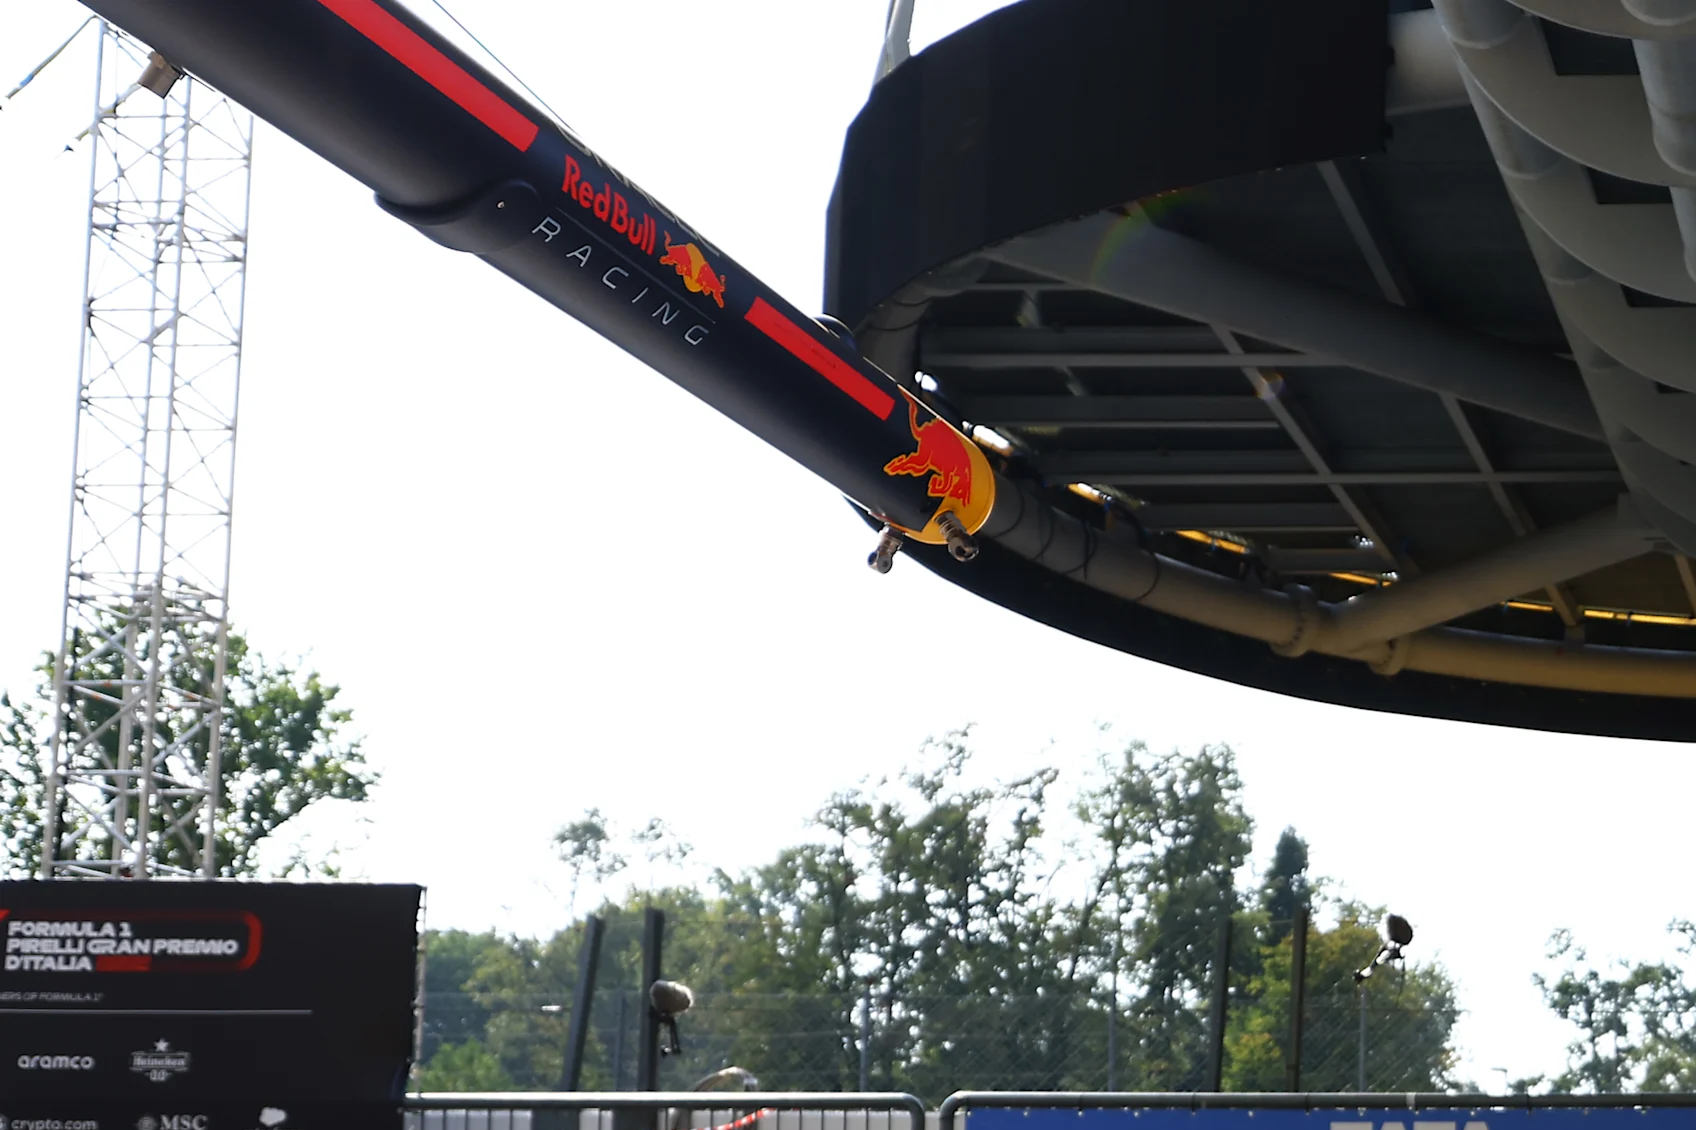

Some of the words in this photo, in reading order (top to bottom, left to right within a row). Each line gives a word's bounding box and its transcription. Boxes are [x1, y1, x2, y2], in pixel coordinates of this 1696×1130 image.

[532, 216, 709, 346] RACING
[7, 921, 115, 938] FORMULA
[118, 921, 133, 937] 1
[6, 938, 86, 955] PIRELLI
[86, 938, 151, 955] GRAN
[152, 938, 240, 956] PREMIO
[17, 1053, 96, 1071] aramco
